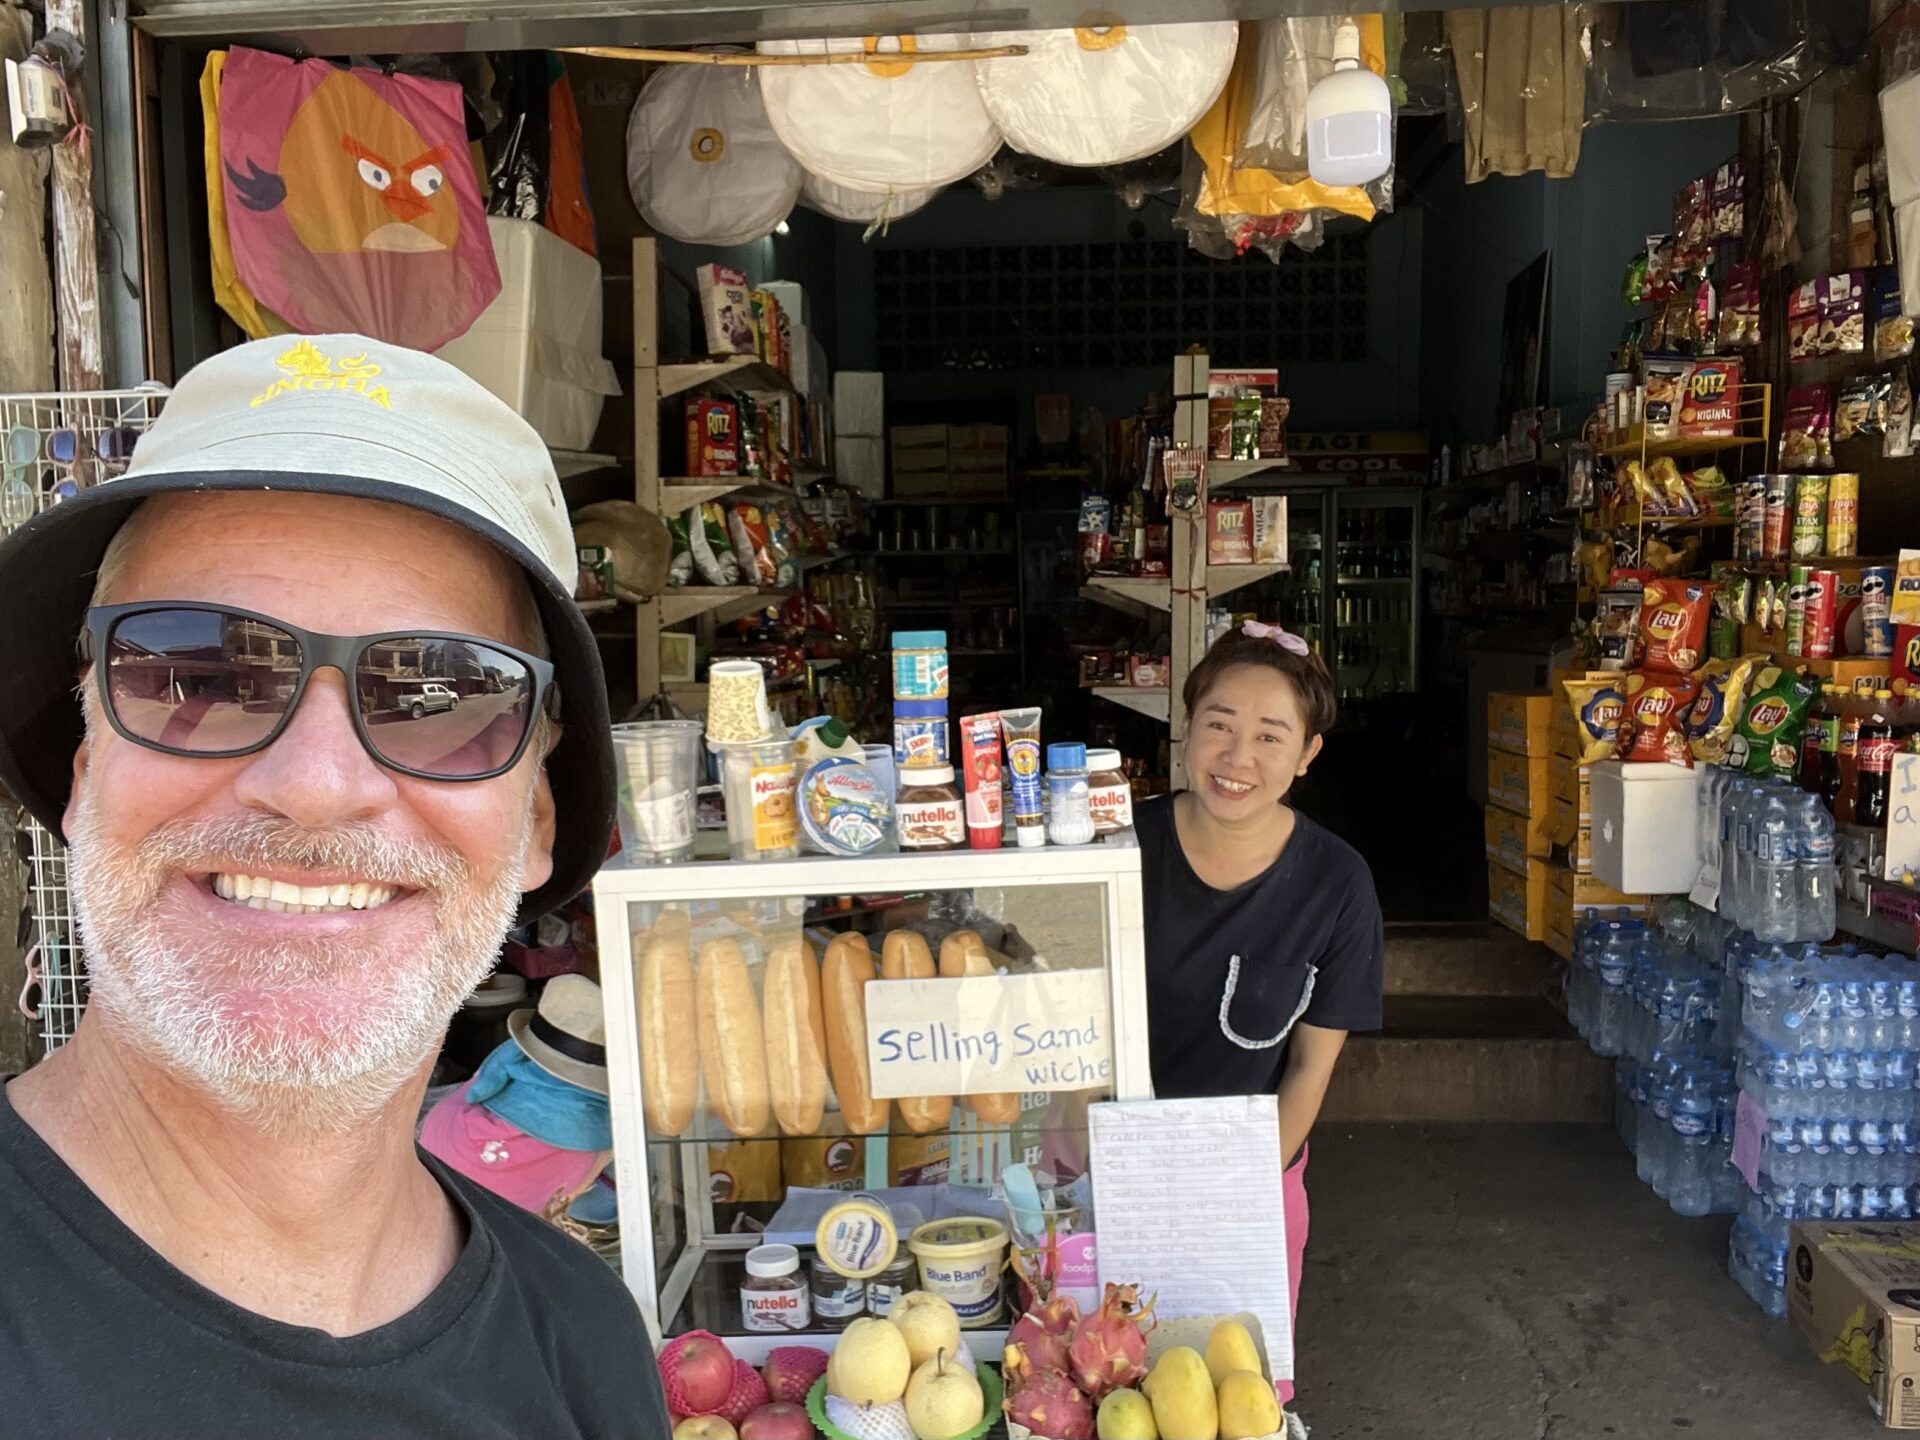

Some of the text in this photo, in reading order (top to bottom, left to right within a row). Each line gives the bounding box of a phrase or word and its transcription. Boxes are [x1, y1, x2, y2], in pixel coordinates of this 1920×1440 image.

[1691, 373, 1727, 400] RITZ
[707, 412, 730, 437] RITZ
[1316, 456, 1404, 472] COOL
[1216, 511, 1245, 532] RITZ
[1796, 517, 1819, 526] STAX
[902, 807, 956, 824] nutella
[877, 1016, 1101, 1065] Selling Sand
[1025, 1056, 1111, 1085] wiche
[846, 1239, 859, 1264] Blue
[926, 1265, 987, 1283] Blue Band
[746, 1295, 798, 1310] nutella
